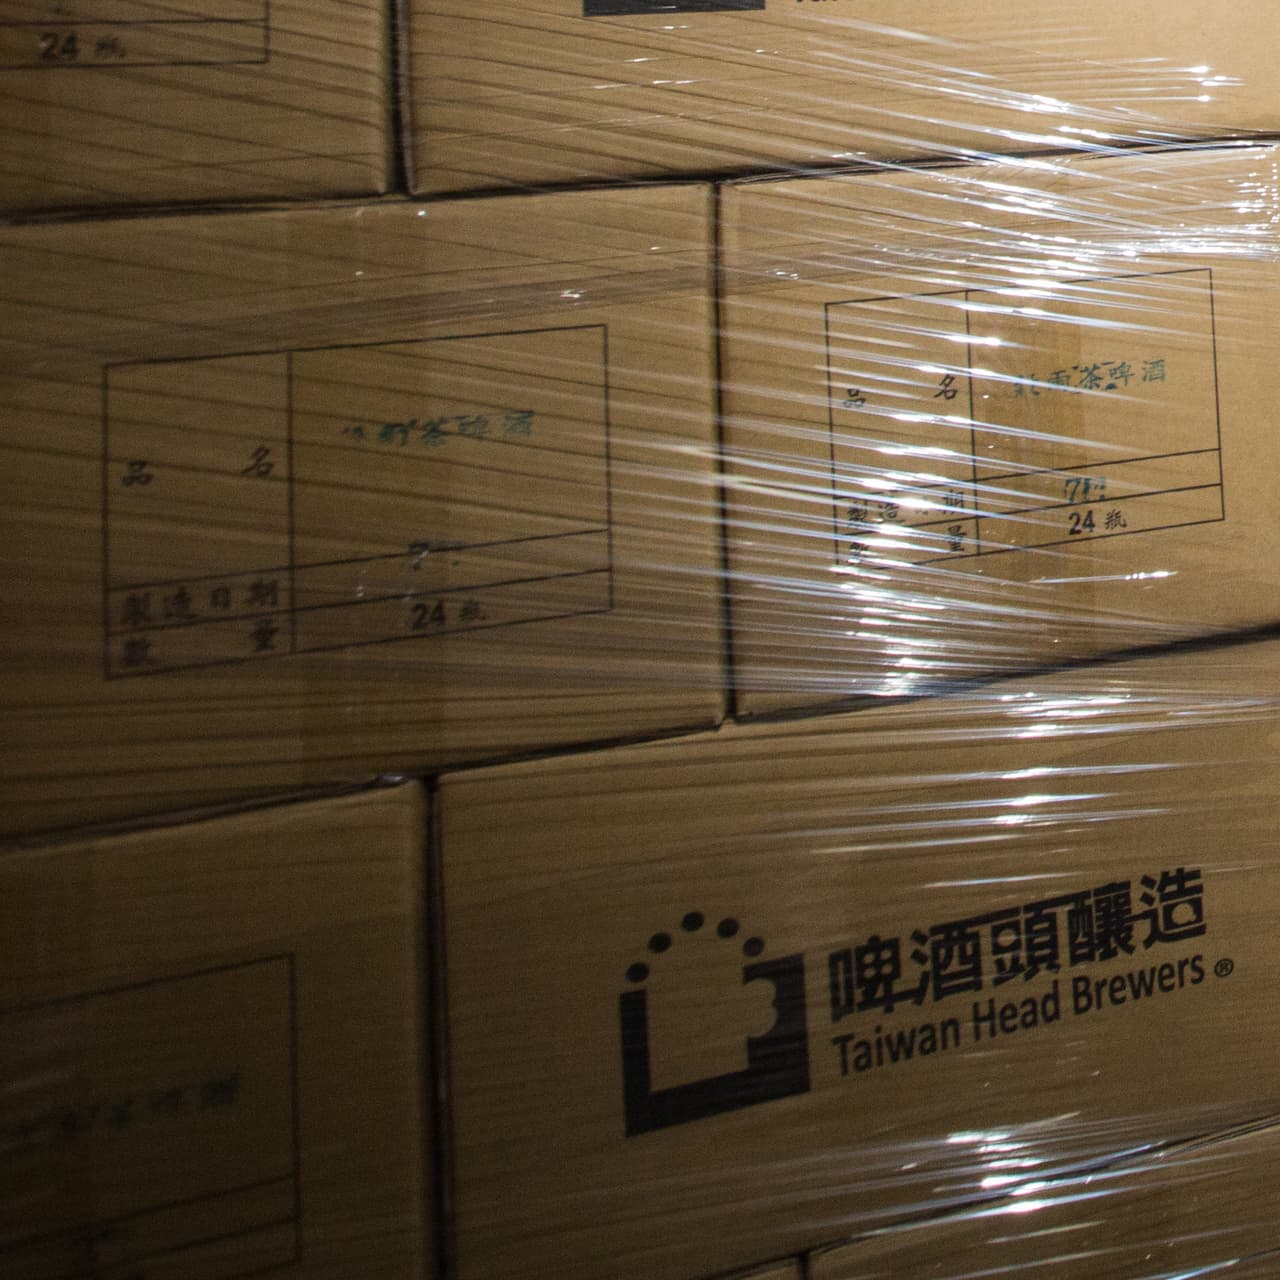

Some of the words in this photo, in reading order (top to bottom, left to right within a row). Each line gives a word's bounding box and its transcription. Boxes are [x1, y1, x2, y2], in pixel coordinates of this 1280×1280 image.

[1068, 509, 1096, 536] 24
[411, 599, 447, 631] 24
[828, 866, 1207, 1023] 啤酒頭釀造
[832, 1018, 961, 1078] Taiwan
[972, 983, 1061, 1043] Head
[1074, 955, 1205, 1017] Brewers
